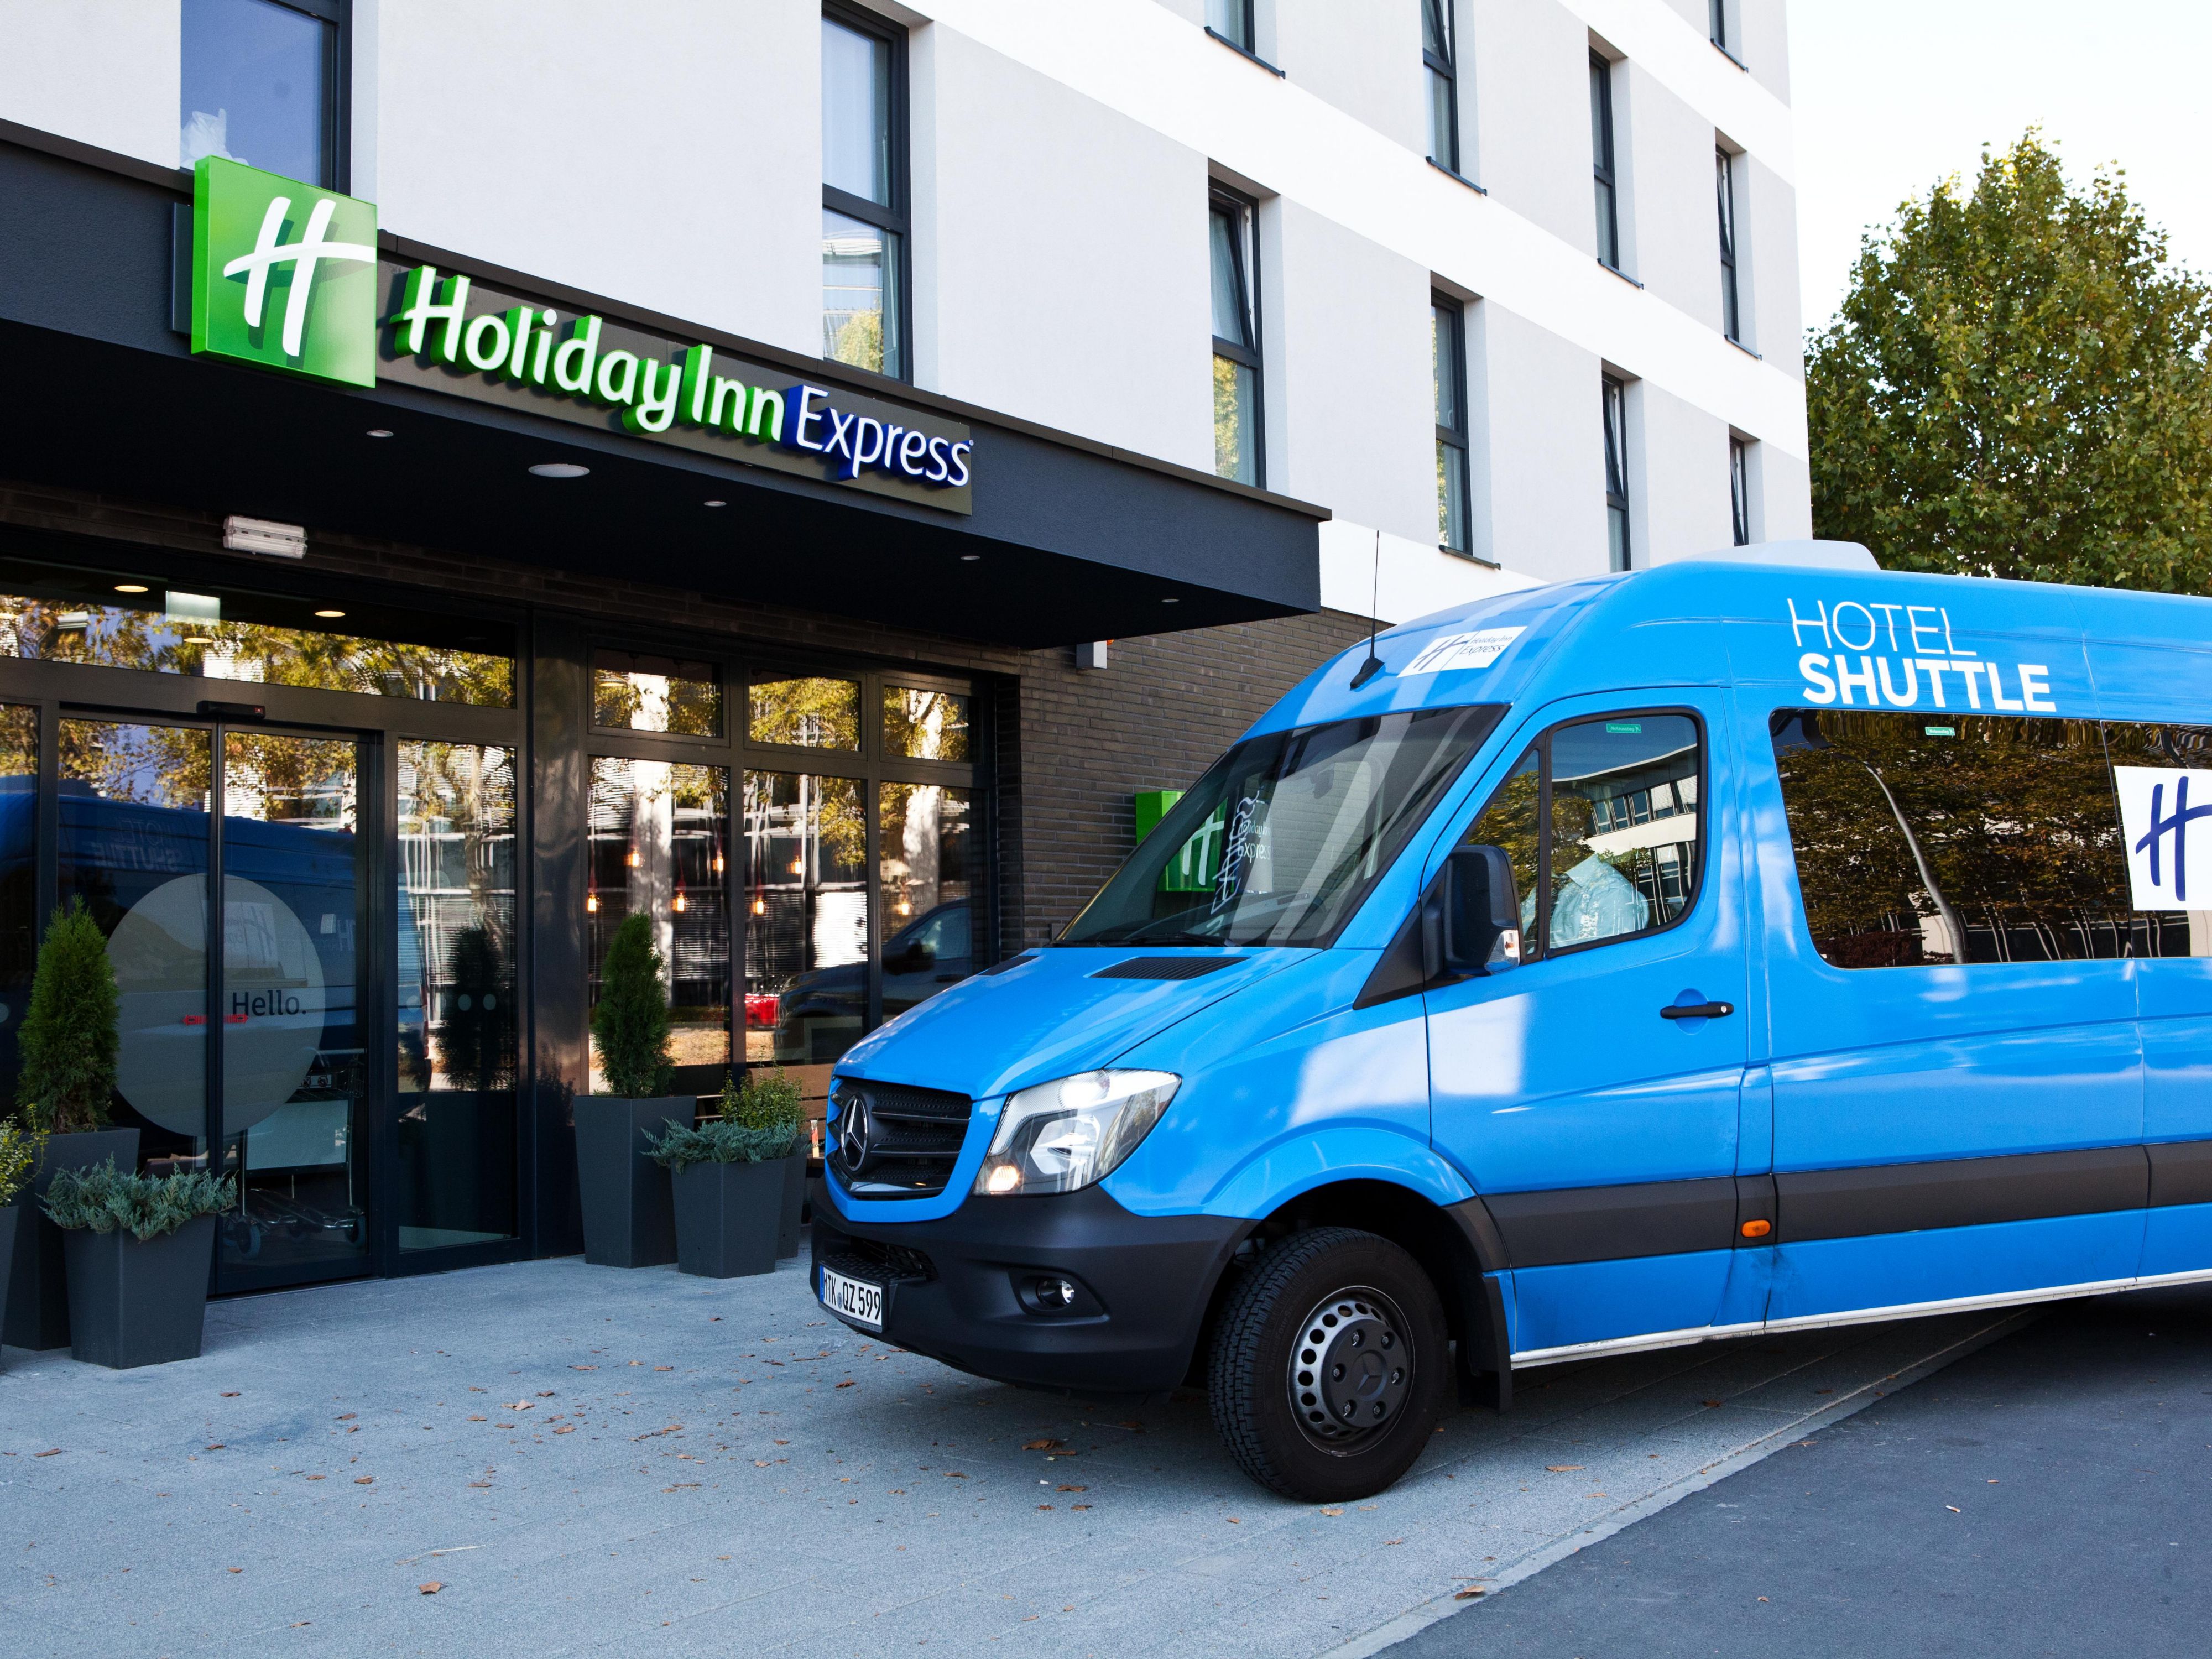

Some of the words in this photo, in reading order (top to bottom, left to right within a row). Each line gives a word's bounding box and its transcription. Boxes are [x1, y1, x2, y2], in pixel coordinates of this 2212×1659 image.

[390, 265, 682, 434] Holiday
[682, 344, 785, 442] Inn
[789, 384, 971, 487] Express
[1787, 598, 1977, 656] HOTEL
[1459, 645, 1505, 656] Express
[1799, 653, 2057, 712] SHUTTLE
[1237, 838, 1271, 863] Express
[232, 990, 307, 1016] Hello.
[843, 1281, 855, 1313] QZ
[859, 1287, 881, 1320] 599
